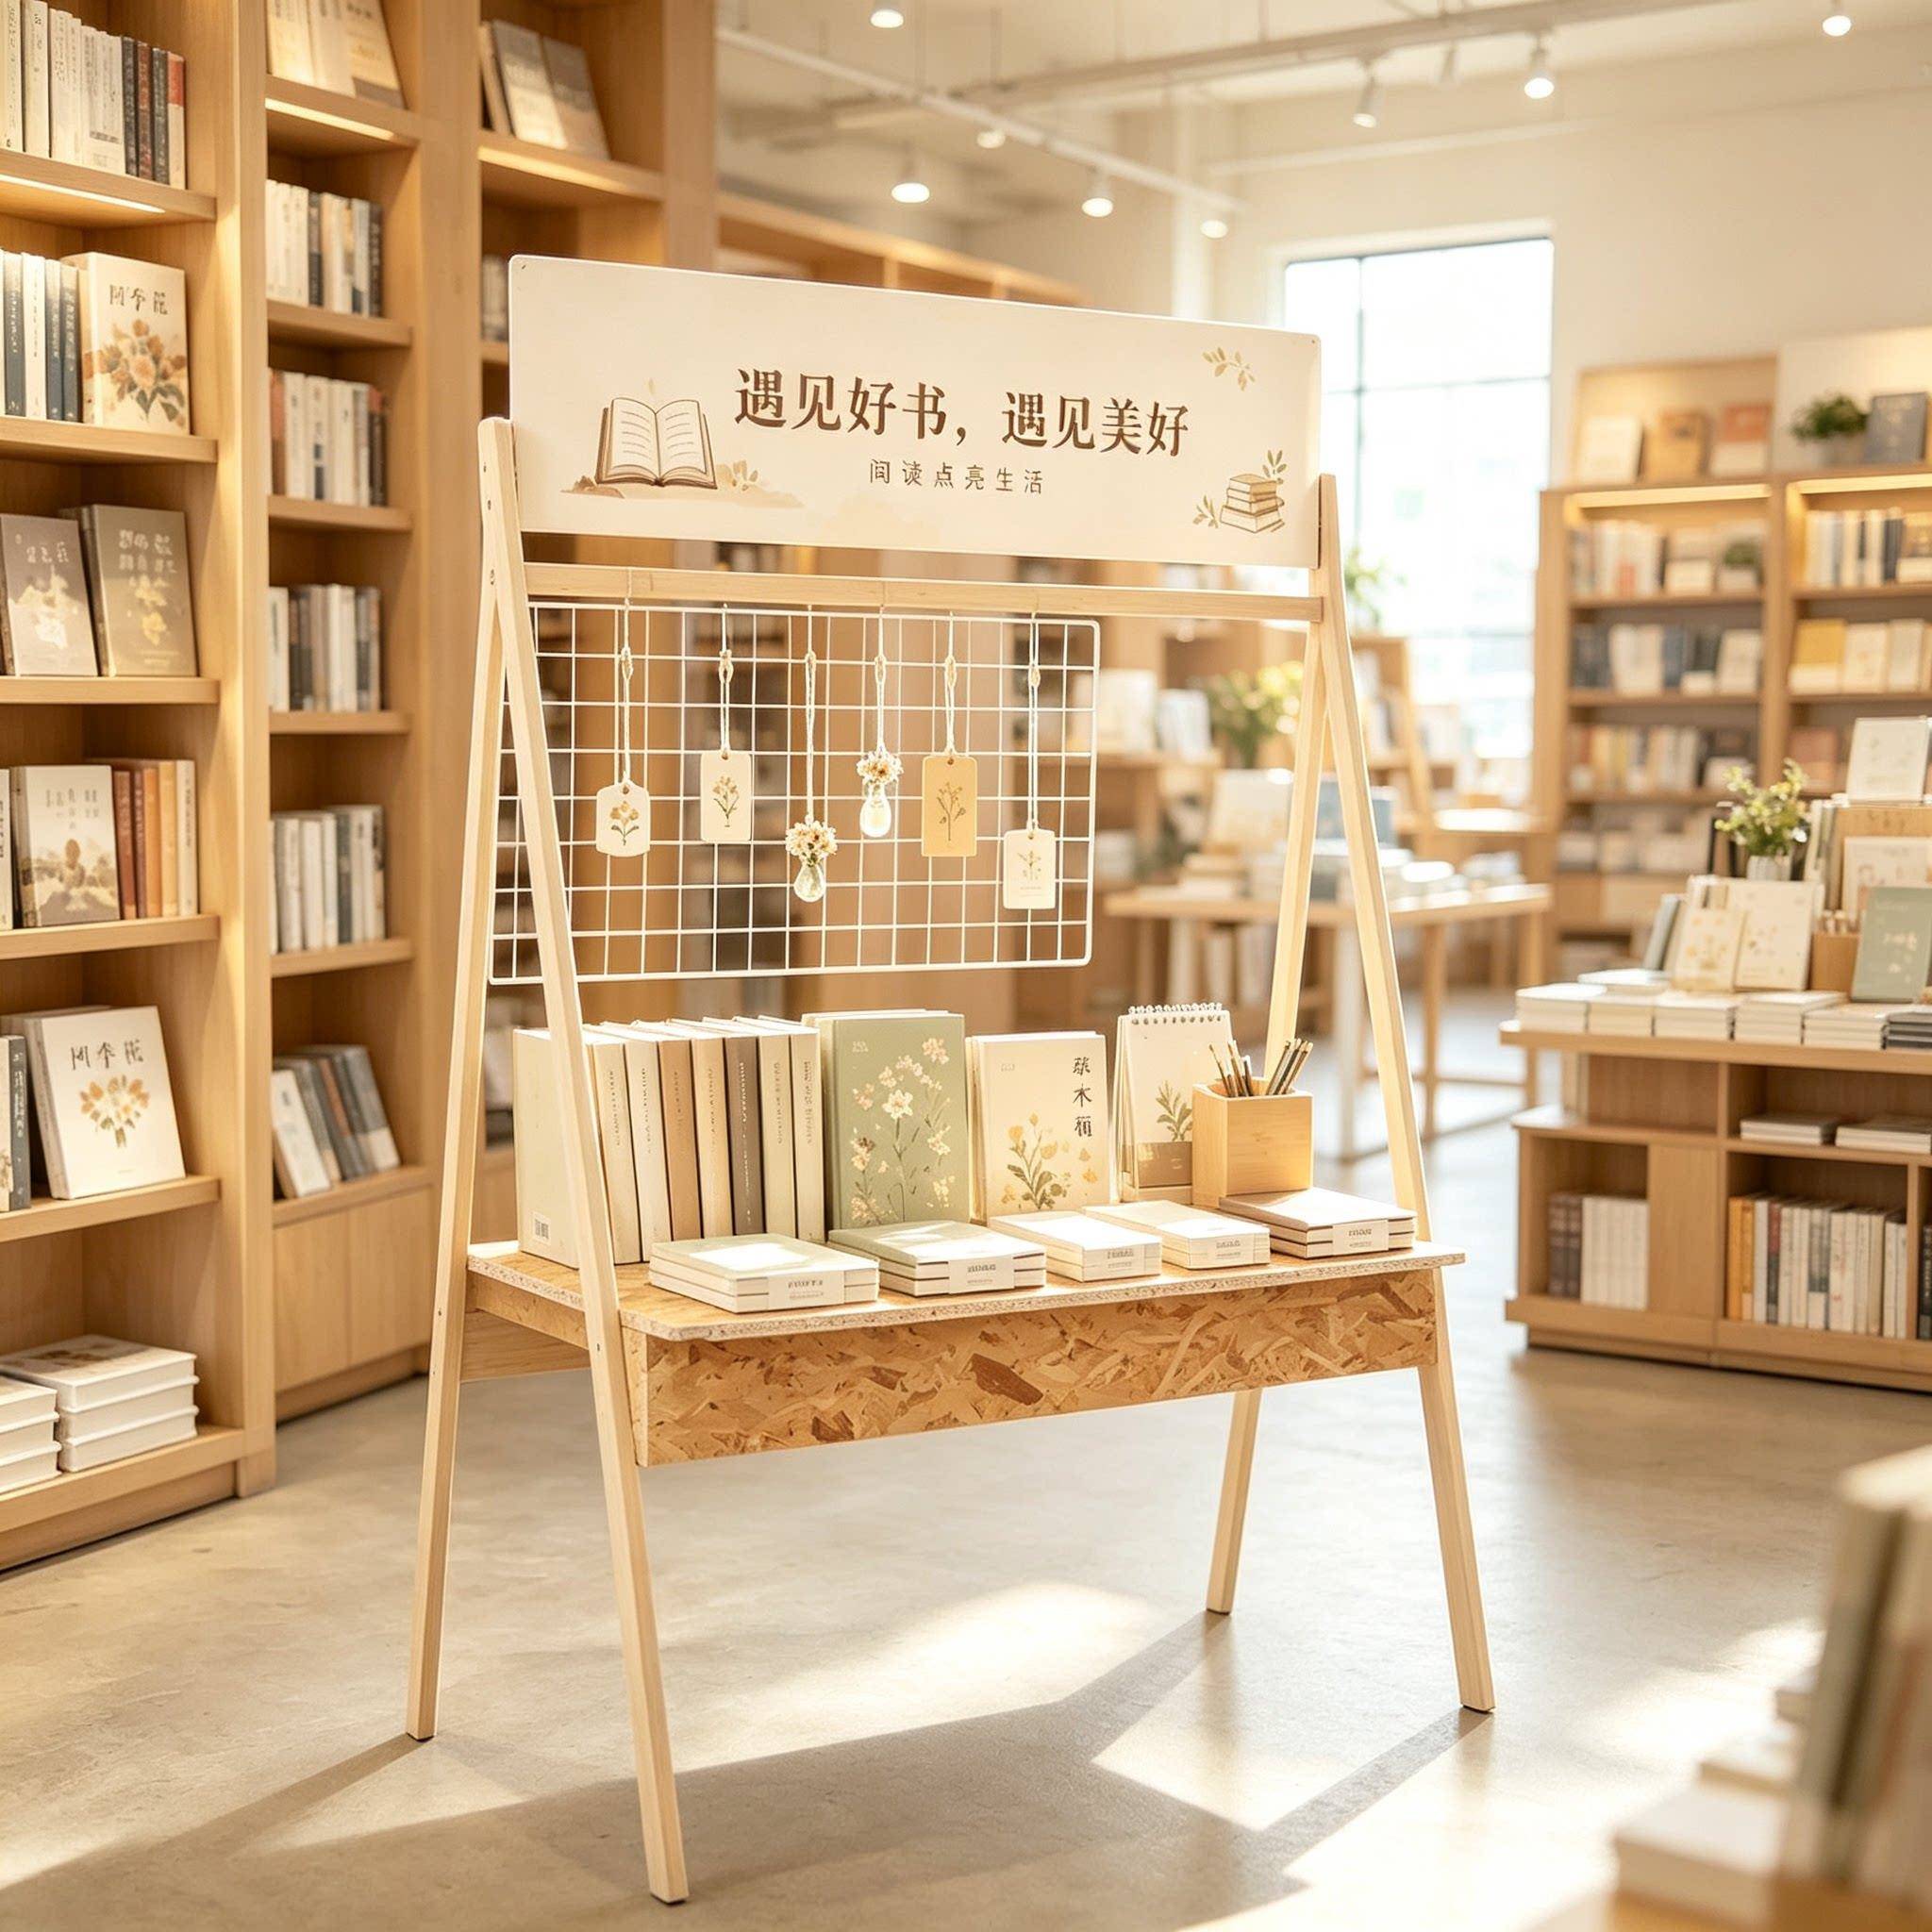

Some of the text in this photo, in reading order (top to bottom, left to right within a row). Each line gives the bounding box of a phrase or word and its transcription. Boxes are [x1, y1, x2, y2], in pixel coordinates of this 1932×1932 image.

[734, 368, 1189, 458] 遇见好书，遇见美好
